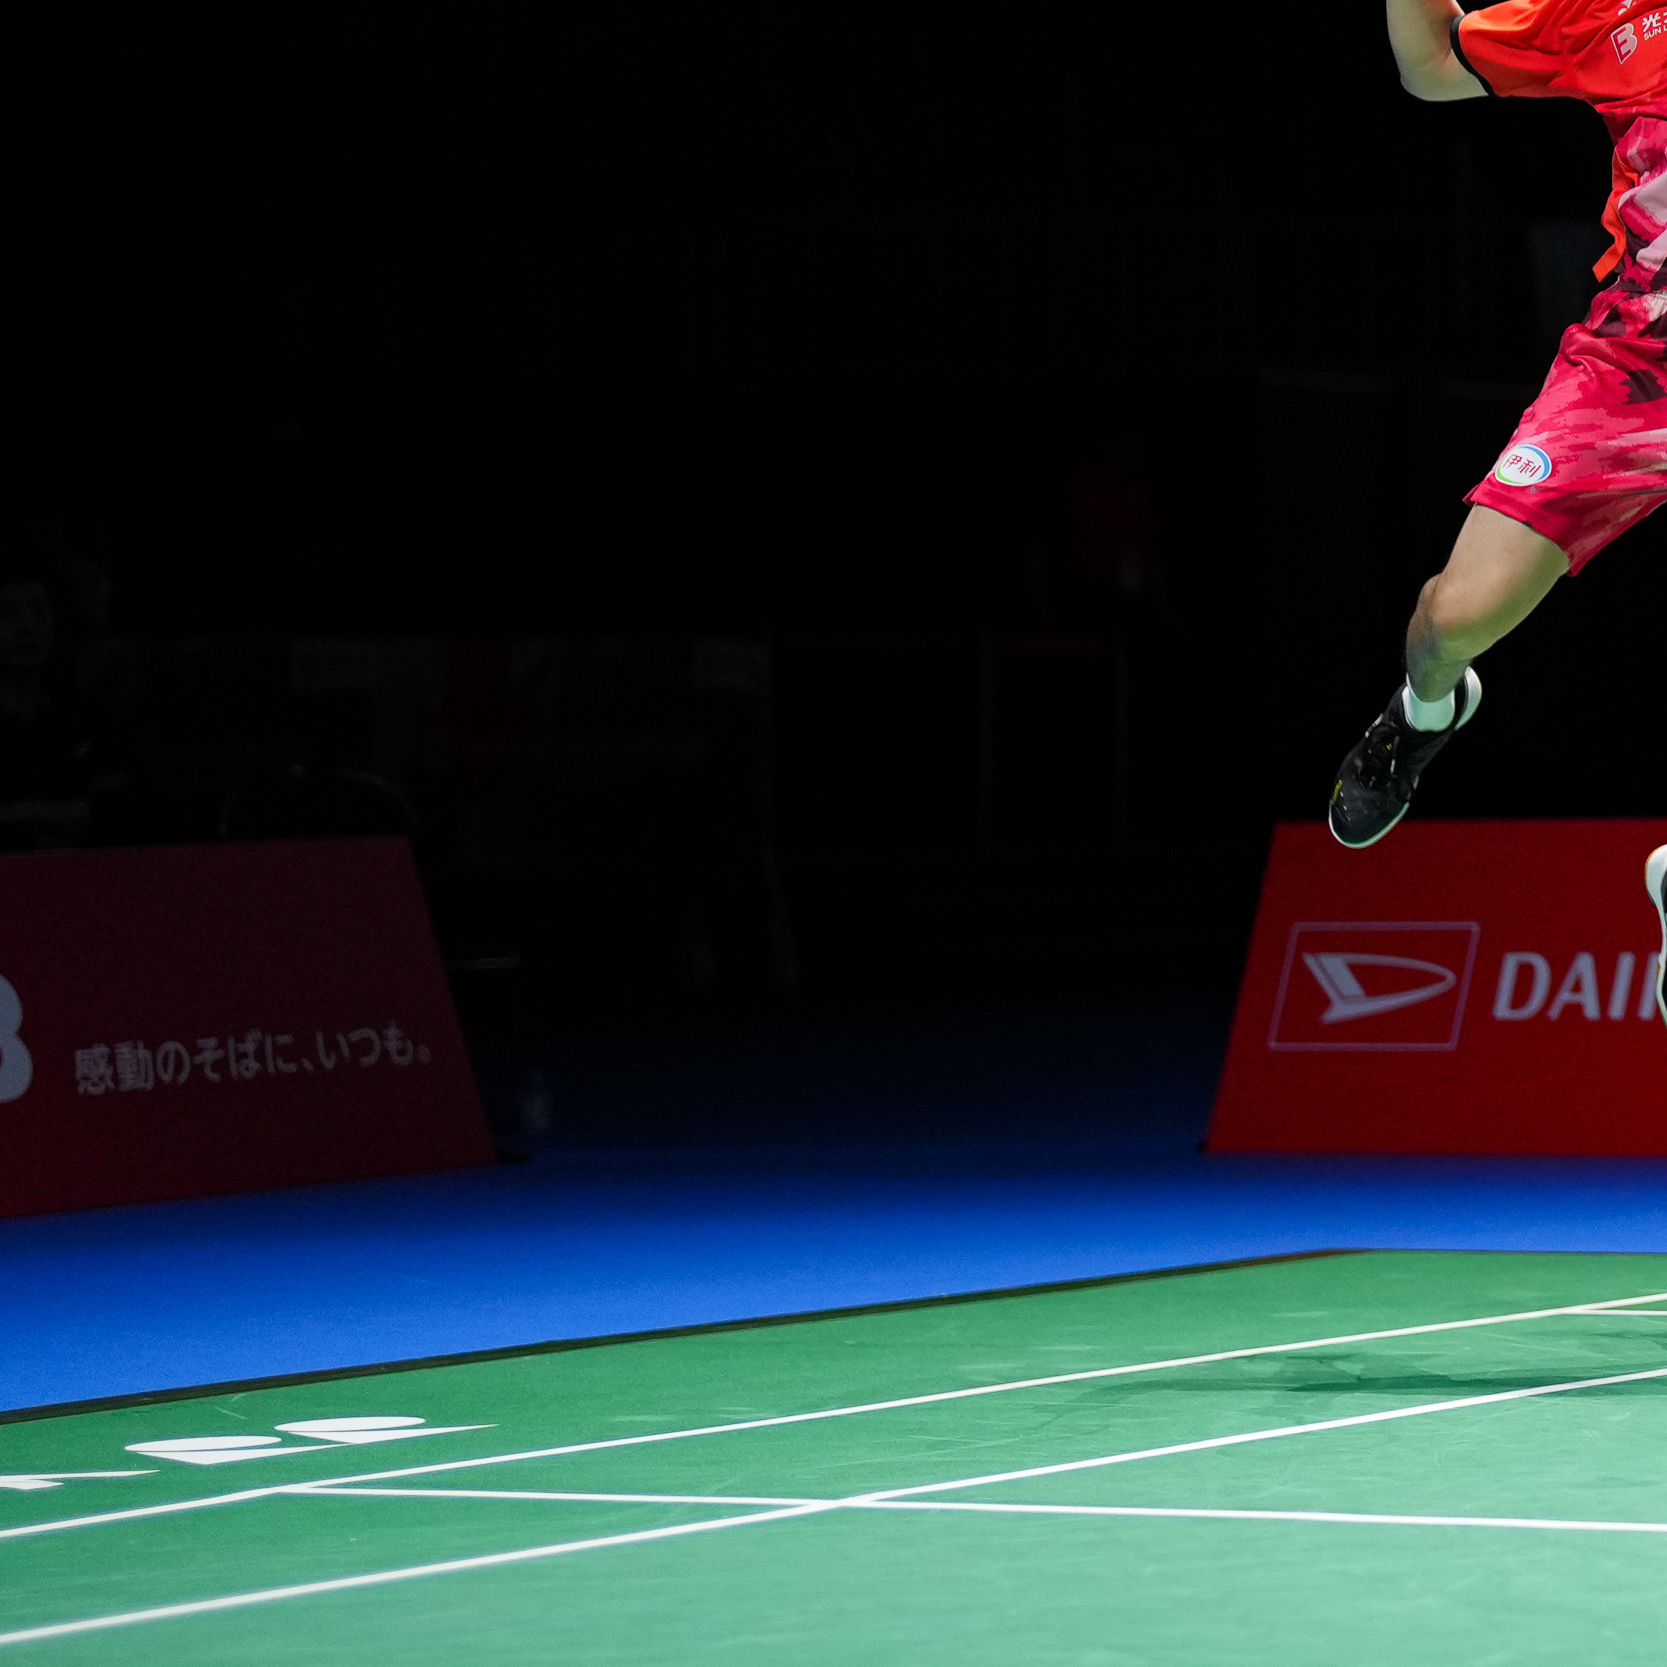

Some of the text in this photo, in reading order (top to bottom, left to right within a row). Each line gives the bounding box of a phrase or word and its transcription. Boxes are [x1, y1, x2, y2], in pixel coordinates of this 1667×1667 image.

[1643, 27, 1662, 40] SUN
[1503, 454, 1541, 477] 伊利
[74, 1021, 431, 1096] 感動のそばに、いつも。
